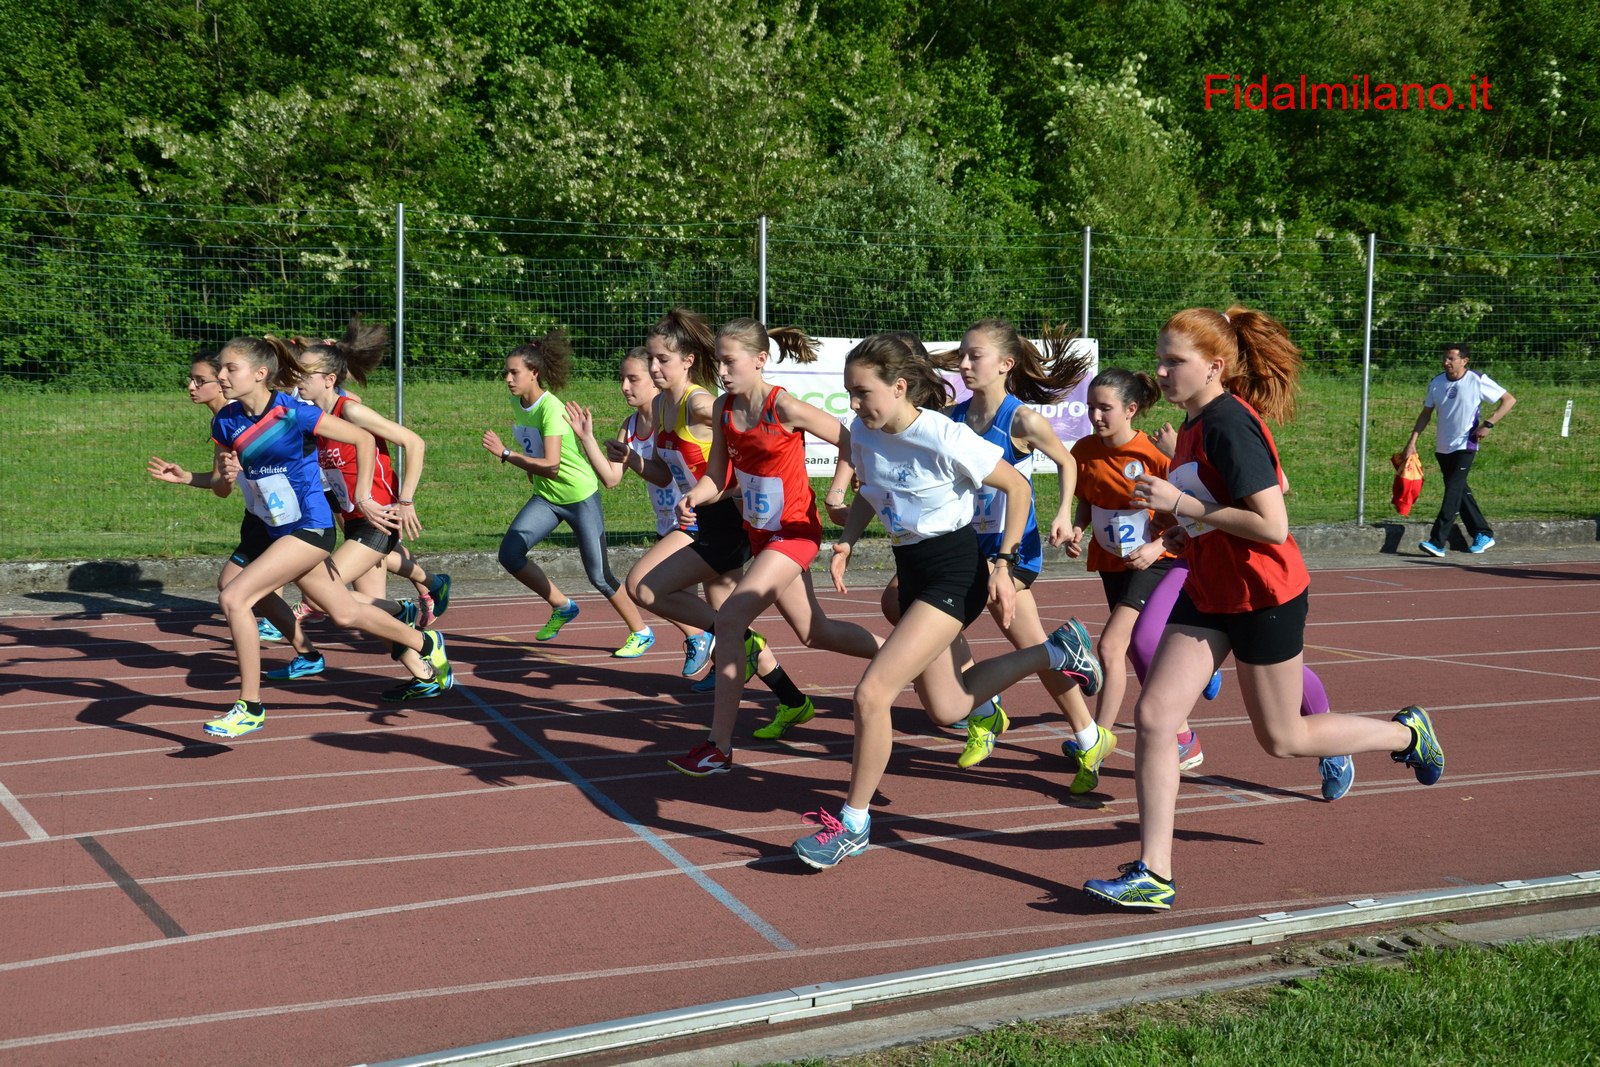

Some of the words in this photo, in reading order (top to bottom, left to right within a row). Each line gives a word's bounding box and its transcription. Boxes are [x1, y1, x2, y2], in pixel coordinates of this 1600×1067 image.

[523, 438, 533, 454] 2
[655, 488, 675, 506] 35
[744, 489, 770, 514] 15
[1103, 524, 1136, 544] 12
